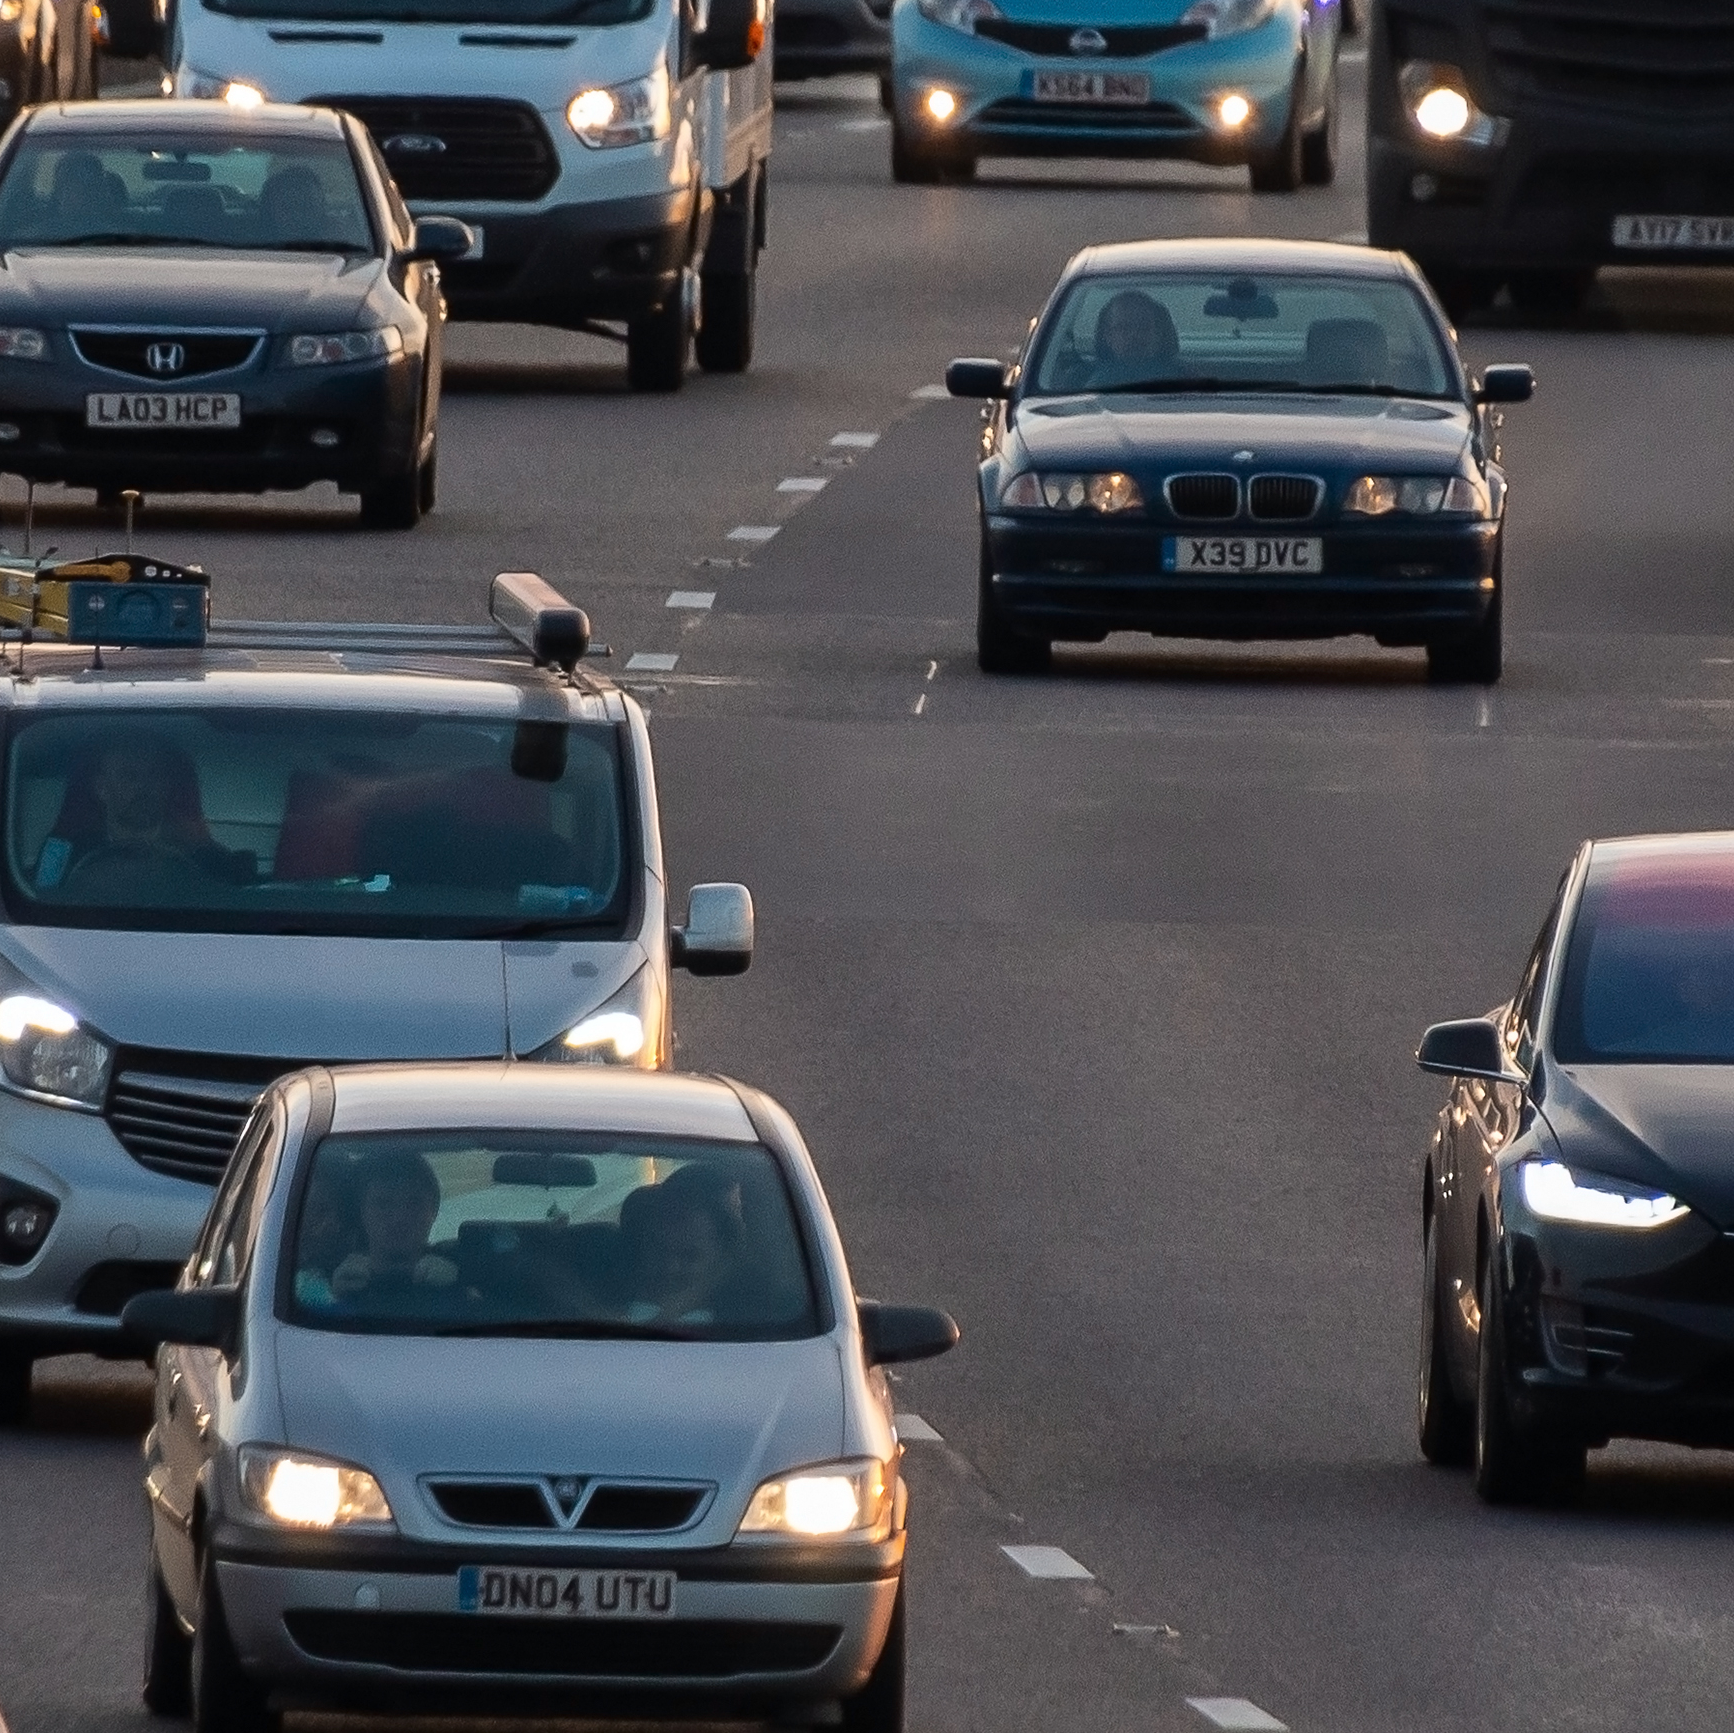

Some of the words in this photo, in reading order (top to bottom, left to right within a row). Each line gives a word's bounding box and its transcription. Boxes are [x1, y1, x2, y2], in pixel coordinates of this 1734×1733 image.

[97, 397, 168, 422] LA03
[175, 398, 228, 423] HCP
[1191, 541, 1246, 567] X39
[1256, 541, 1309, 568] DVC
[483, 1573, 582, 1611] DN04
[596, 1576, 673, 1613] UTU
